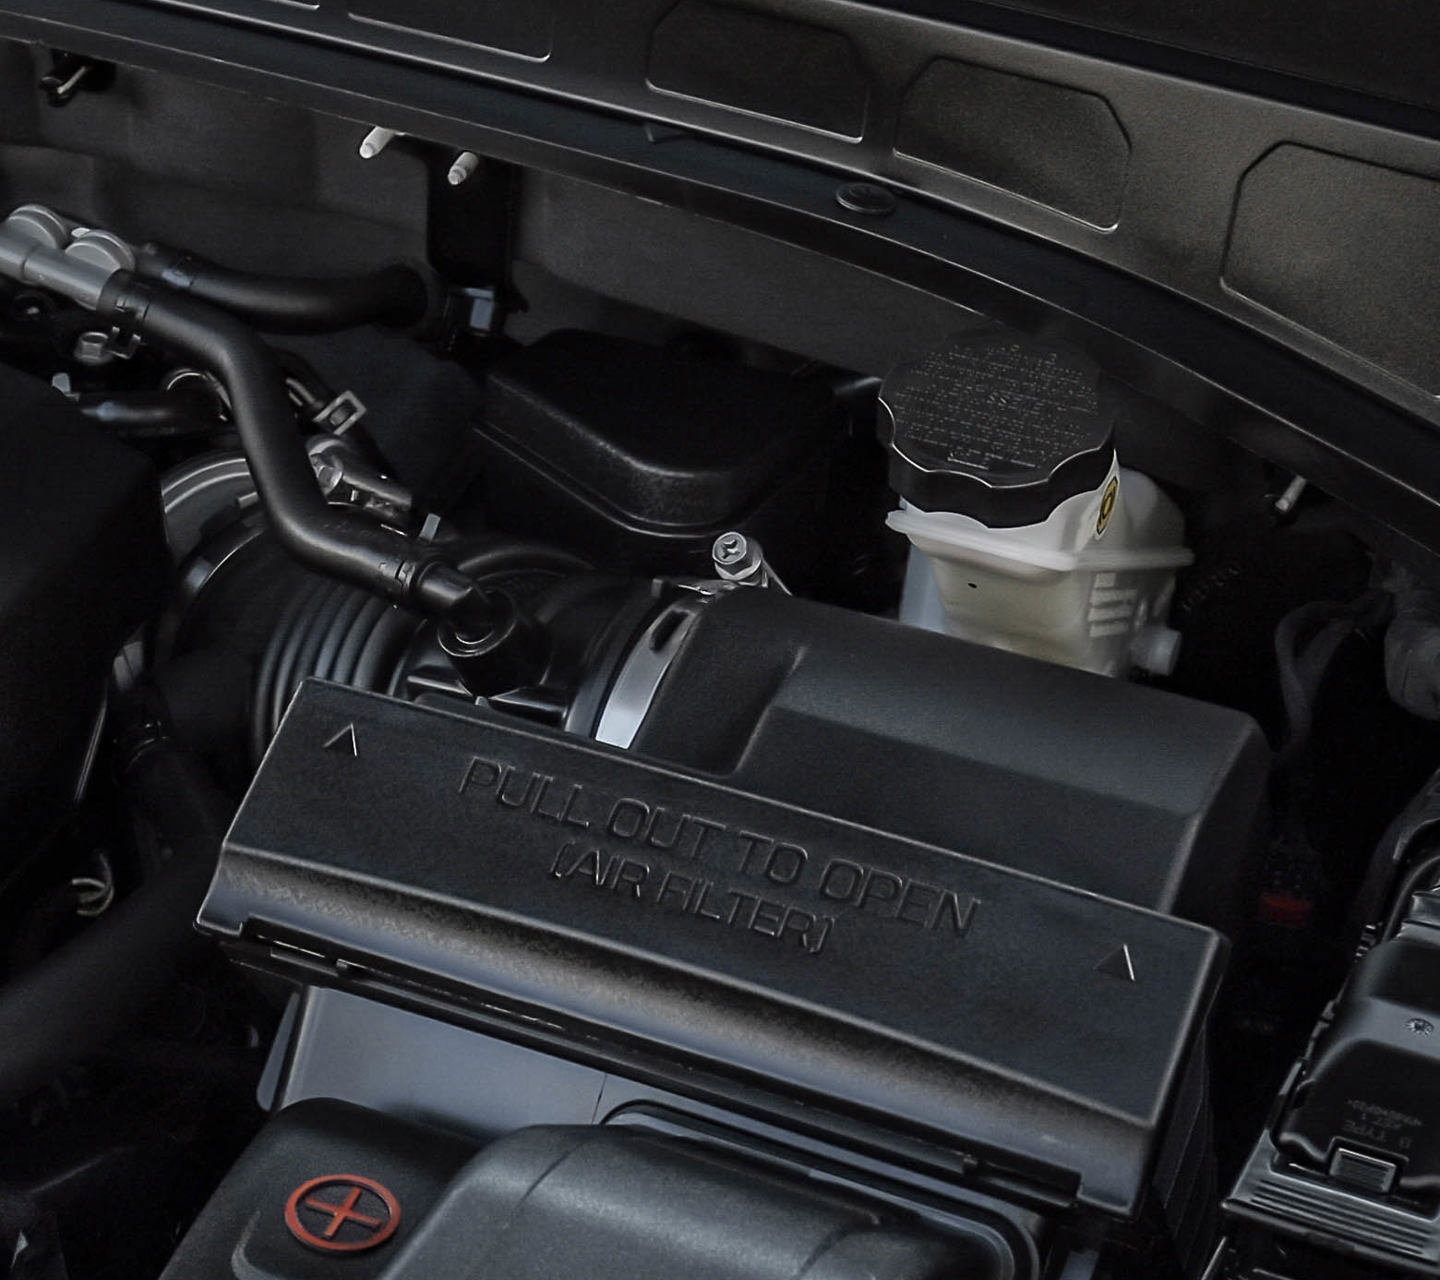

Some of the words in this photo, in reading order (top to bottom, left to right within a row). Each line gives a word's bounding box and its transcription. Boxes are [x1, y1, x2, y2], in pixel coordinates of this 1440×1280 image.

[457, 756, 590, 831] PULL
[605, 797, 730, 864] OUT
[737, 828, 810, 888] TO
[816, 860, 983, 940] OPEN
